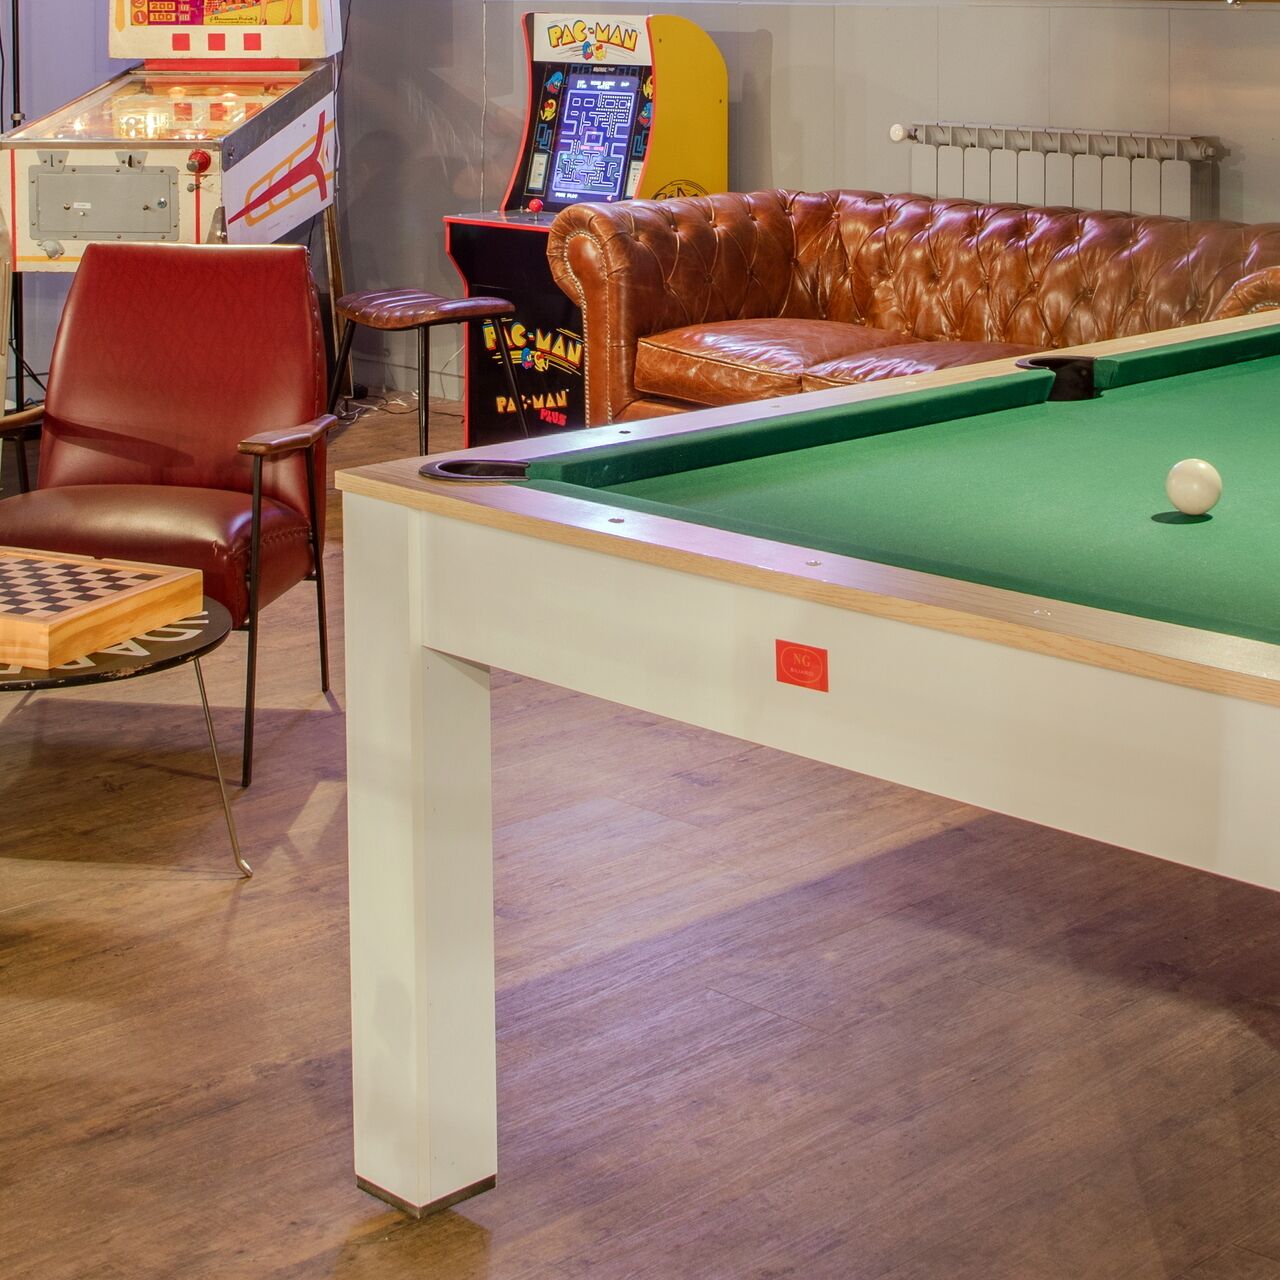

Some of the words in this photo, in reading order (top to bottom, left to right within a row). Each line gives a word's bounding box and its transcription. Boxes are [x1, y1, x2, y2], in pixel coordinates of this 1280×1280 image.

[137, 12, 142, 22] 1
[547, 19, 638, 52] PAC-MAN
[539, 408, 568, 427] PLUS
[793, 652, 811, 667] NG
